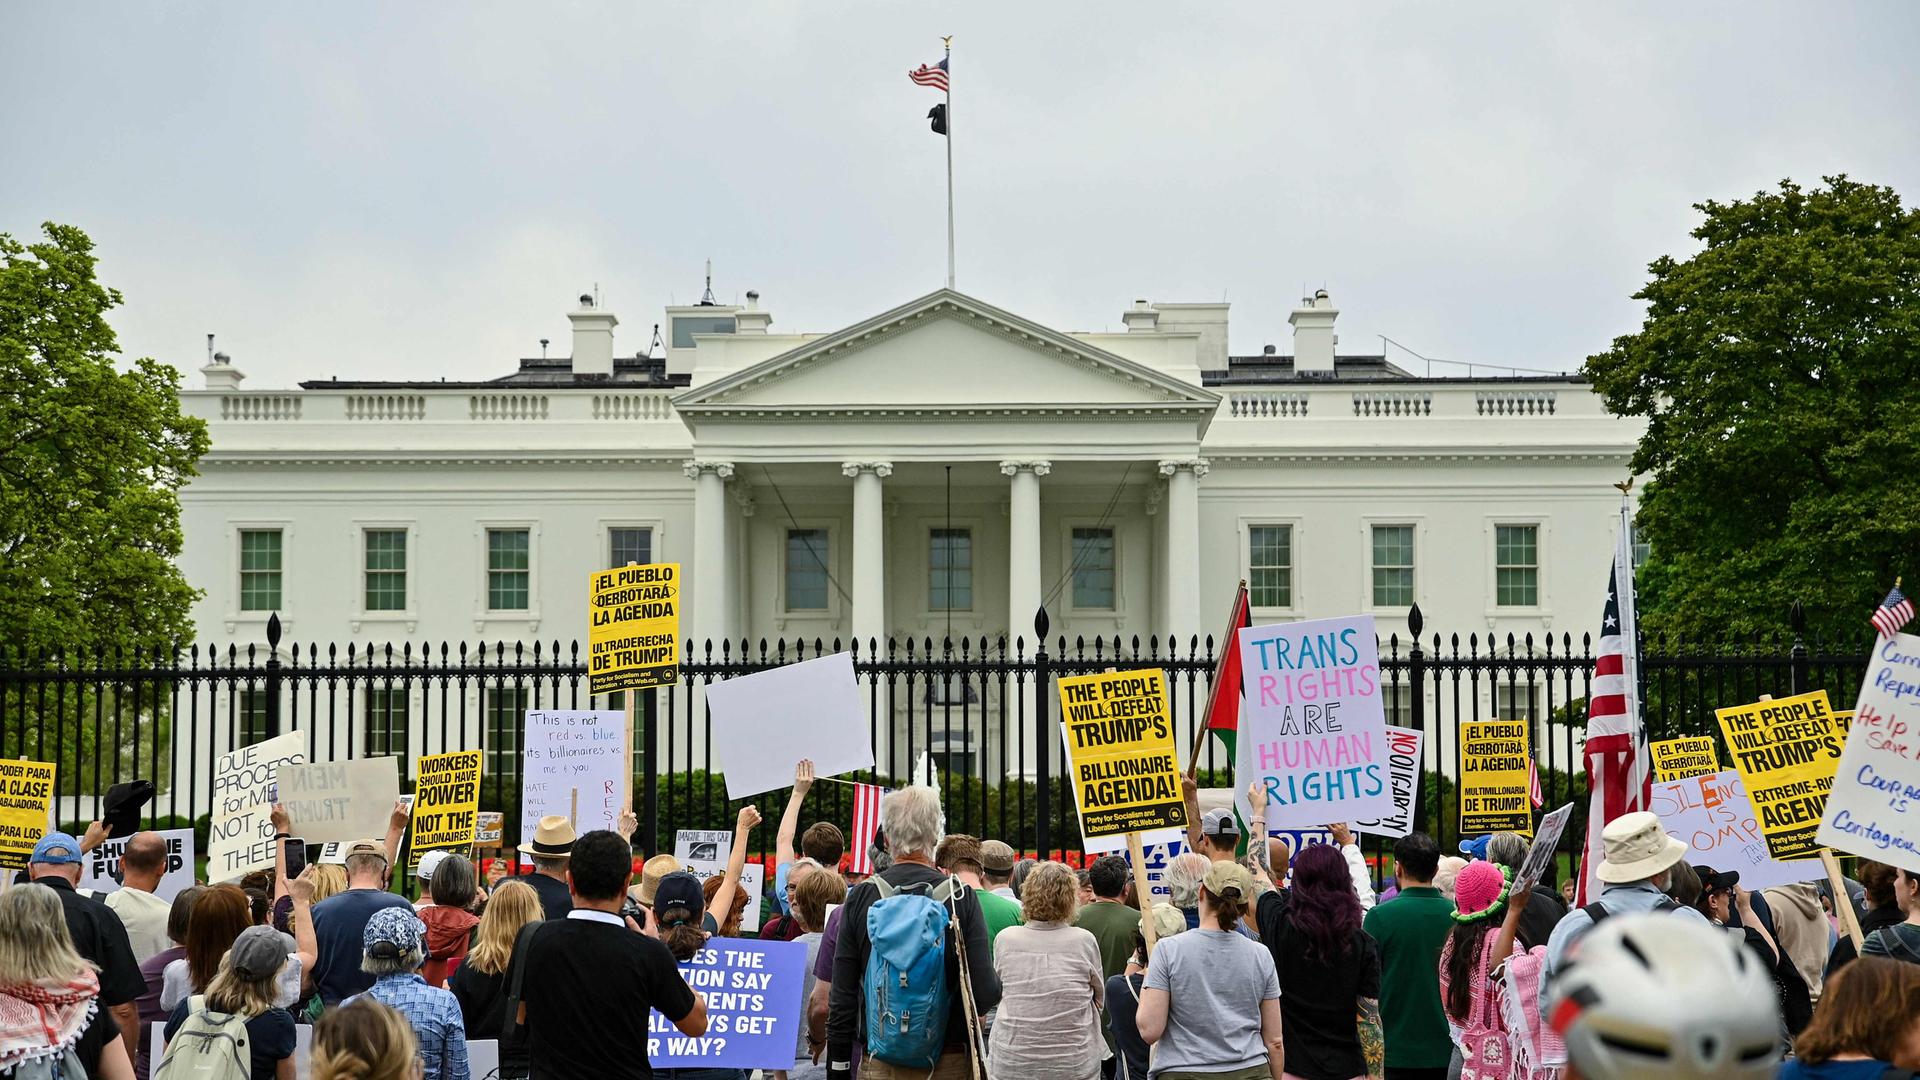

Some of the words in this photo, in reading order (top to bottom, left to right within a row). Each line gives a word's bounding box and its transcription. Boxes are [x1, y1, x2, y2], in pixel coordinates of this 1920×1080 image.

[595, 574, 615, 593] ¡EL
[618, 567, 673, 586] PUEBLO
[597, 584, 670, 607] DERROTARÁ
[593, 610, 610, 626] LA
[613, 602, 674, 623] AGENDA
[592, 633, 674, 654] ULTRADERECHA
[1251, 628, 1359, 670] TRANS
[593, 654, 611, 671] DE
[614, 647, 673, 667] TRUMP!
[593, 683, 617, 691] Liberation
[1064, 683, 1098, 703] THE
[1100, 677, 1160, 699] PEOPLE
[1259, 664, 1376, 707] RIGHTS
[530, 713, 560, 725] This
[567, 716, 576, 726] is
[582, 715, 598, 726] not
[1069, 703, 1108, 722] WILL
[1110, 697, 1162, 717] DEFEAT
[1280, 702, 1342, 736] ARE
[1724, 712, 1759, 732] THE
[1760, 699, 1827, 726] PEOPLE
[1071, 715, 1168, 748] TRUMP'S
[1857, 704, 1907, 738] Help
[549, 729, 569, 741] red
[1391, 732, 1418, 755] NO
[1466, 726, 1481, 741] ¡EL
[1484, 725, 1523, 739] PUEBLO
[1732, 733, 1768, 750] WILL
[1773, 719, 1832, 742] DEFEAT
[549, 745, 605, 760] billionaires
[1258, 731, 1373, 770] HUMAN
[1468, 740, 1523, 755] DERROTARÁ
[1656, 744, 1673, 759] ¡EL
[1675, 740, 1710, 754] PUEBLO
[1737, 736, 1842, 775] TRUMP'S
[1865, 731, 1908, 759] Save
[219, 746, 258, 775] DUE
[421, 754, 478, 775] WORKERS
[543, 766, 557, 774] me
[1080, 755, 1174, 782] BILLIONAIRE
[1465, 758, 1479, 772] LA
[1481, 757, 1526, 771] AGENDA
[1661, 753, 1713, 770] DERROTARÁ
[26, 767, 51, 780] PARA
[214, 754, 304, 797] PROCE
[420, 773, 452, 787] SHOULD
[454, 770, 477, 783] HAVE
[10, 780, 49, 798] CLASE
[418, 782, 475, 808] POWER
[525, 783, 548, 792] HATE
[1084, 775, 1177, 808] AGENDA!
[1263, 764, 1383, 806] RIGHTS
[1465, 786, 1526, 796] MULTIMILLONARIA
[1652, 774, 1748, 817] SILENC
[1752, 776, 1835, 803] EXTREME-RI
[0, 797, 45, 813] ABAJADORA,
[222, 796, 247, 816] for
[249, 782, 278, 808] ME
[603, 780, 614, 833] RESI
[1465, 798, 1479, 812] DE
[1482, 797, 1525, 811] TRUMP!
[416, 814, 443, 834] NOT
[447, 810, 474, 830] THE
[1086, 816, 1103, 824] Party
[1113, 812, 1144, 821] Socialism
[1144, 809, 1156, 817] and
[1707, 806, 1737, 824] IS
[1761, 794, 1829, 829] AGEN
[0, 825, 21, 838] PARA
[23, 827, 42, 840] LOS
[213, 812, 254, 843] NOT
[257, 819, 275, 839] fo
[1088, 824, 1120, 833] Liberation
[1128, 818, 1164, 828] PSLWeb.org
[415, 830, 472, 846] BILLIONAIRES!
[1770, 836, 1787, 845] Party
[1798, 831, 1817, 840] Socia
[1773, 842, 1806, 854] Liberation
[92, 841, 127, 860] SHU
[223, 839, 277, 871] THEE
[93, 859, 120, 880] FU
[1151, 886, 1171, 895] GE
[724, 950, 765, 969] THE
[678, 968, 725, 988] TION
[731, 971, 773, 990] SAY
[697, 991, 765, 1012] DENTS
[648, 1015, 729, 1033] ALYS
[735, 1016, 777, 1035] GET
[667, 1038, 726, 1056] WAY?
